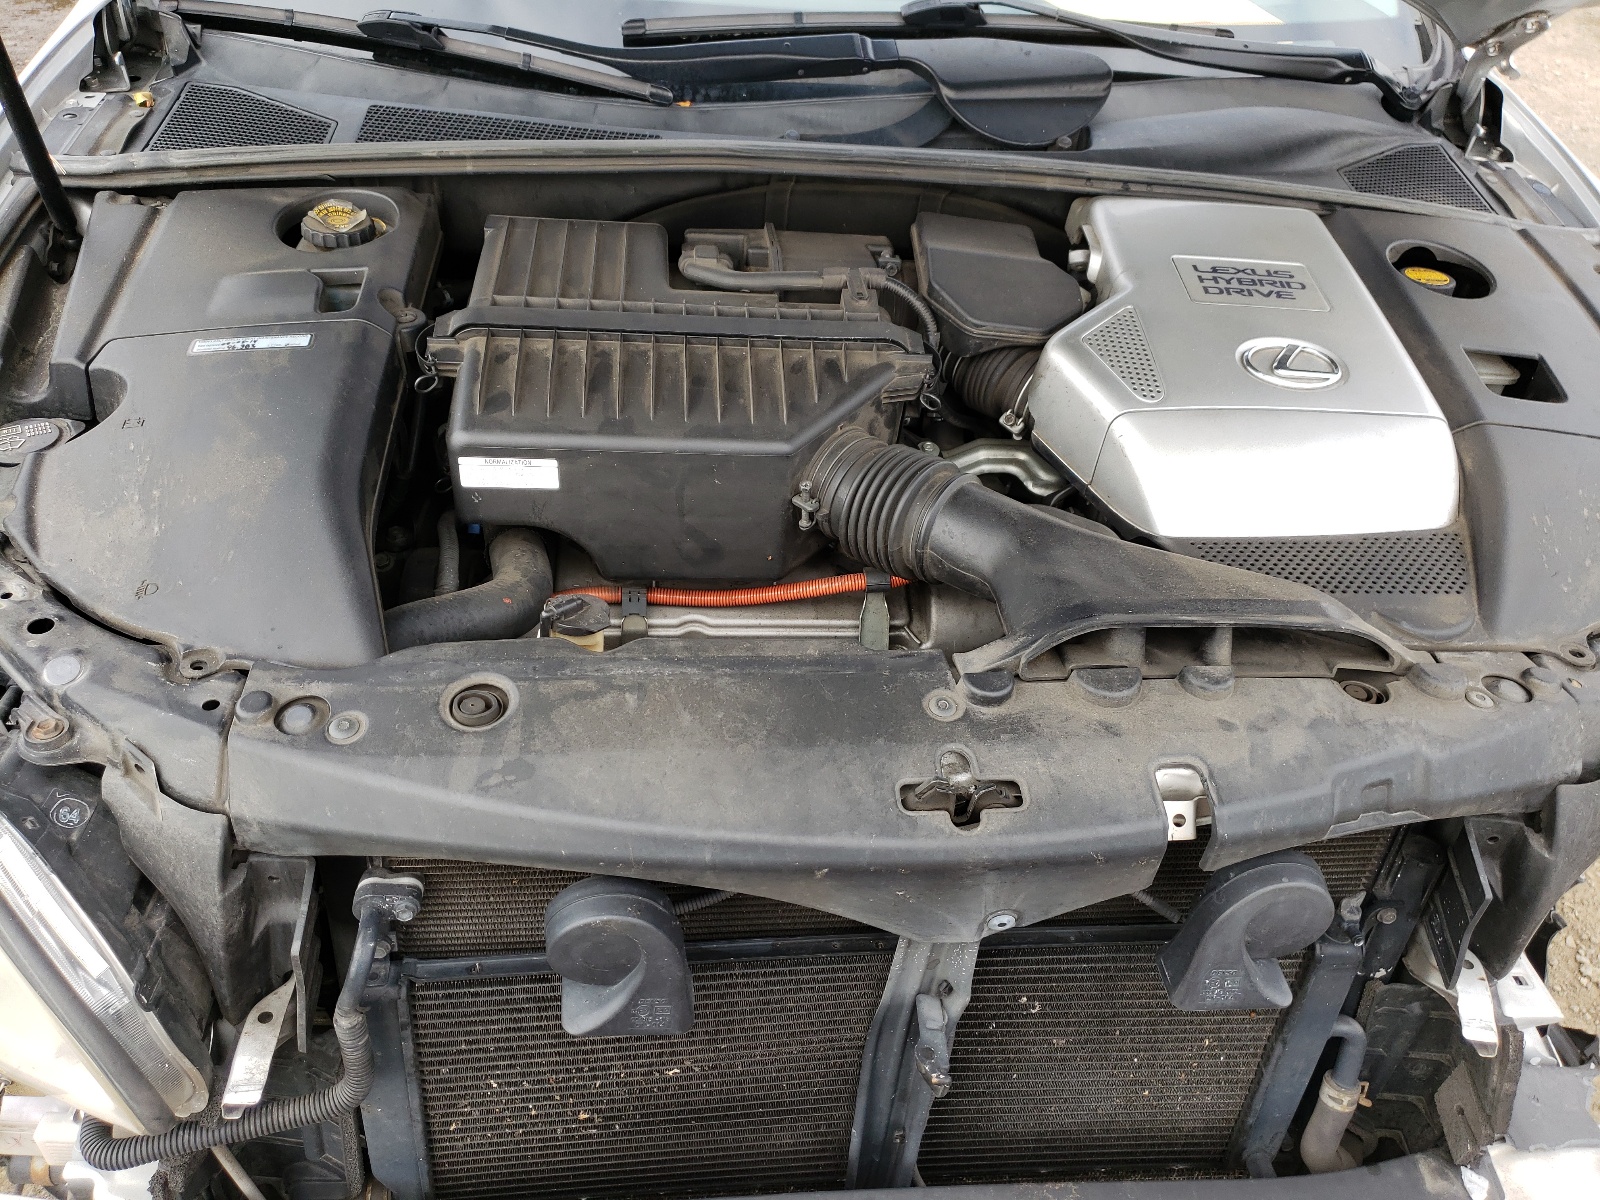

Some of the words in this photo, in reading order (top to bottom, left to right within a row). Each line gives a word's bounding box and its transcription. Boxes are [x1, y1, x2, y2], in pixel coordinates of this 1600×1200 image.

[1192, 264, 1295, 279] LEXUS
[1197, 275, 1306, 290] HYBRID
[1202, 285, 1296, 300] DRIVE
